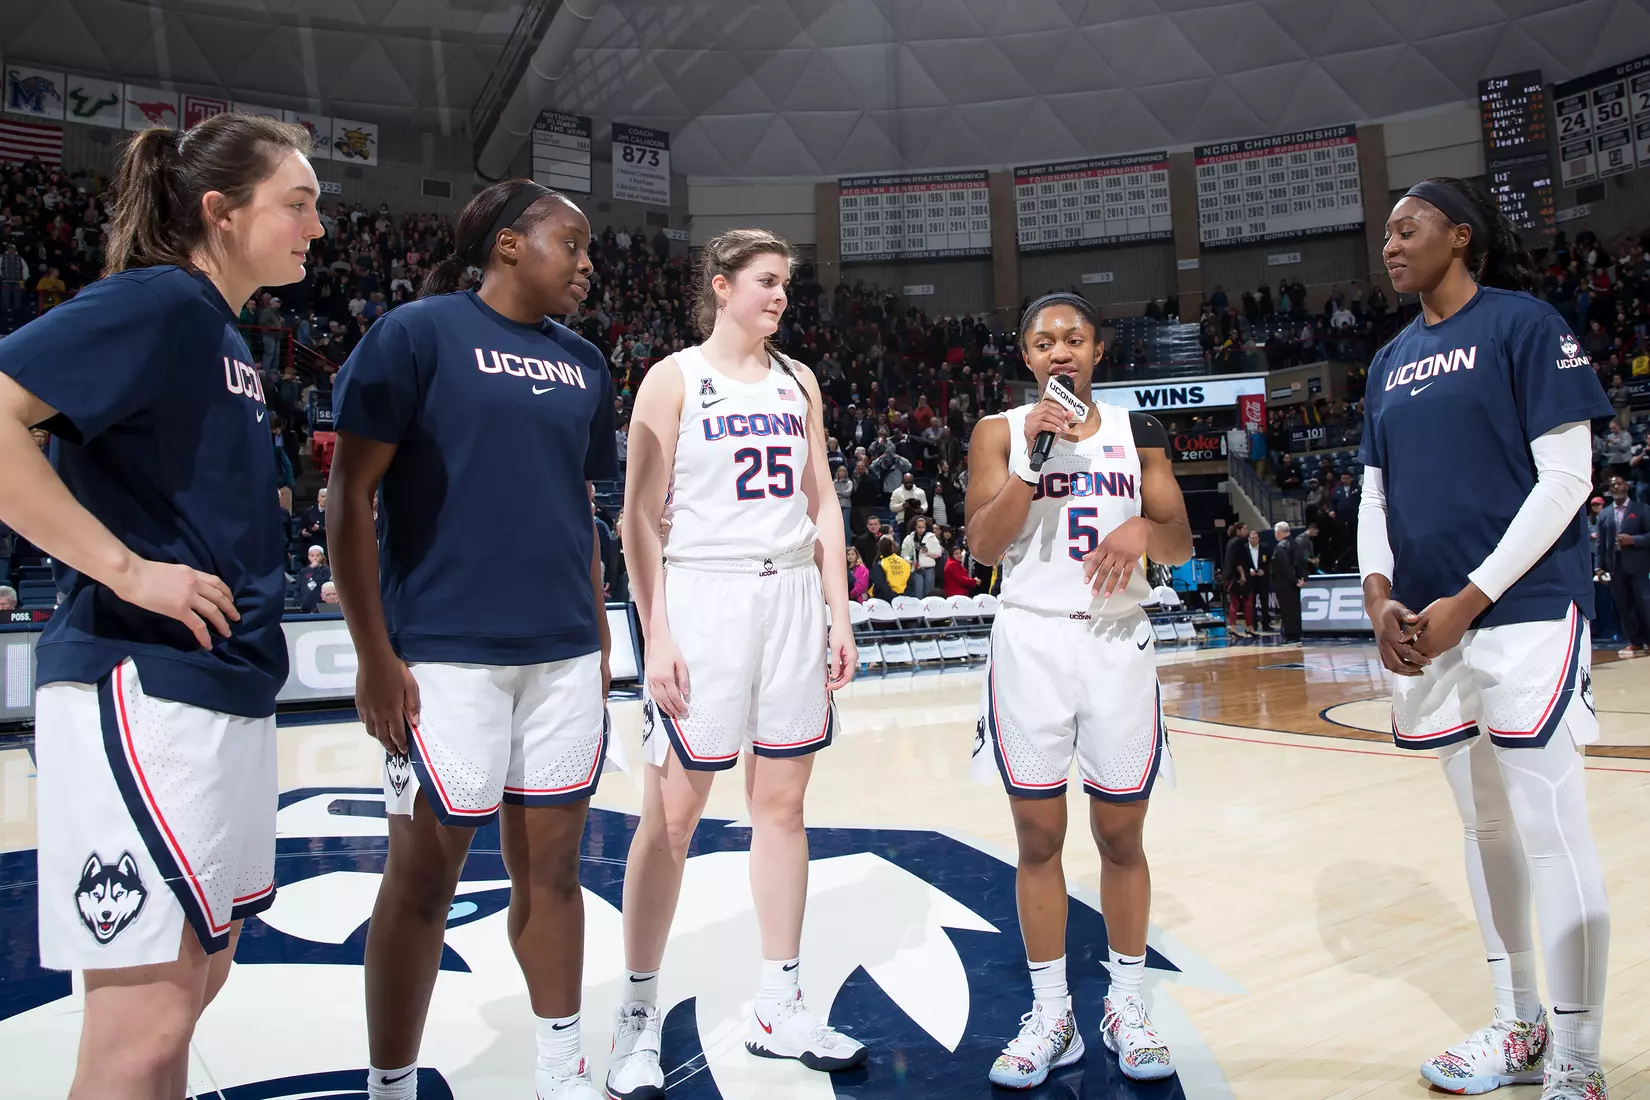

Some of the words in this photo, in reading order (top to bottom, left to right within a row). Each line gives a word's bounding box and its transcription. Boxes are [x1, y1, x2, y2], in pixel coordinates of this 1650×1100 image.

[1561, 112, 1586, 134] 24
[1597, 101, 1623, 122] 50
[550, 125, 565, 133] THE
[567, 128, 587, 137] YEAR
[628, 128, 653, 137] COACH
[1204, 144, 1238, 154] NCAA
[1244, 127, 1346, 149] CHAMPIONSHIP
[617, 134, 629, 142] JIM
[630, 136, 665, 148] CALHOUN
[622, 145, 660, 167] 873
[1204, 150, 1269, 164] TOURNAMENT
[1274, 138, 1349, 154] APPEARANCES
[1055, 163, 1088, 171] AMERICAN
[1089, 159, 1120, 168] ATHLETIC
[1122, 154, 1164, 164] CONFERENCE
[1199, 166, 1215, 177] 1989
[1222, 163, 1237, 174] 1990
[1245, 160, 1260, 171] 1991
[1267, 157, 1283, 168] 1992
[1290, 153, 1307, 164] 1993
[1314, 150, 1330, 160] 1994
[1337, 146, 1355, 157] 1995
[1030, 172, 1092, 184] TOURNAMENT
[1098, 164, 1153, 176] CHAMPIONS
[1200, 182, 1216, 192] 1996
[1223, 178, 1238, 189] 1997
[1246, 175, 1262, 186] 1998
[1268, 172, 1284, 182] 1999
[1291, 169, 1309, 180] 2000
[1315, 165, 1332, 176] 2001
[1338, 162, 1356, 173] 2002
[320, 182, 340, 192] 222
[931, 182, 986, 190] CHAMPIONS
[1019, 187, 1034, 196] 1989
[1040, 185, 1055, 194] 1991
[1061, 182, 1077, 192] 1994
[1084, 180, 1099, 189] 1995
[1105, 177, 1121, 187] 1996
[1127, 175, 1143, 185] 1997
[1150, 172, 1165, 182] 1998
[1200, 197, 1218, 208] 2003
[1223, 194, 1241, 205] 2004
[1246, 191, 1264, 202] 2005
[1269, 188, 1287, 199] 2006
[1292, 184, 1309, 196] 2007
[1316, 181, 1334, 192] 2008
[1340, 178, 1358, 189] 2009
[842, 198, 858, 207] 1989
[864, 197, 879, 206] 1990
[886, 196, 900, 205] 1991
[906, 195, 922, 204] 1994
[928, 194, 942, 202] 1995
[950, 192, 964, 201] 1996
[971, 191, 986, 200] 1997
[1020, 202, 1035, 211] 1999
[1062, 197, 1078, 207] 2001
[1084, 194, 1100, 205] 2002
[1106, 192, 1123, 202] 2005
[843, 213, 858, 222] 1998
[864, 211, 880, 220] 1999
[885, 210, 902, 220] 2000
[907, 209, 923, 218] 2001
[928, 208, 944, 217] 2002
[949, 207, 966, 216] 2003
[971, 206, 987, 215] 2004
[1041, 214, 1057, 224] 2010
[1064, 212, 1079, 222] 2011
[1086, 210, 1101, 220] 2012
[1107, 208, 1124, 217] 2014
[1129, 205, 1146, 215] 2015
[1152, 202, 1167, 213] 2016
[1202, 212, 1219, 224] 2010
[1225, 209, 1241, 220] 2011
[1248, 206, 1264, 217] 2012
[1271, 203, 1287, 214] 2013
[1293, 200, 1311, 211] 2014
[1317, 197, 1335, 208] 2015
[1341, 194, 1358, 205] 2016
[672, 231, 688, 240] 223
[843, 228, 859, 237] 2007
[864, 226, 880, 236] 2008
[886, 225, 902, 234] 2009
[908, 224, 924, 233] 2010
[929, 223, 945, 232] 2011
[950, 222, 967, 231] 2014
[972, 220, 988, 230] 2015
[1021, 230, 1036, 241] 2017
[1043, 229, 1058, 239] 2018
[1065, 227, 1081, 237] 2019
[1203, 229, 1219, 240] 2017
[1226, 226, 1242, 237] 2018
[1249, 222, 1266, 233] 2019
[1205, 233, 1260, 247] CONNECTICUT
[1264, 230, 1302, 239] WOMEN'S
[1306, 224, 1360, 234] BASKETBALL
[843, 242, 858, 252] 2016
[865, 241, 880, 250] 2017
[886, 240, 901, 249] 2018
[908, 238, 924, 248] 2019
[1020, 241, 1075, 251] CONNECTICUT
[1079, 236, 1116, 245] WOMEN'S
[1119, 231, 1172, 242] BASKETBALL
[939, 249, 989, 257] BASKETBALL
[474, 348, 588, 390] UCONN
[1384, 346, 1477, 392] UCONN
[1050, 382, 1077, 408] UCONN
[1134, 386, 1205, 408] WINS
[319, 410, 334, 418] SE
[702, 412, 806, 441] UCONN
[1306, 428, 1324, 439] 101
[1174, 434, 1219, 452] Coke
[1182, 450, 1213, 460] zero
[734, 446, 794, 501] 25
[1068, 506, 1099, 562] 5
[759, 569, 778, 578] UCONN
[1300, 587, 1369, 620] GE
[11, 612, 32, 622] POSS.
